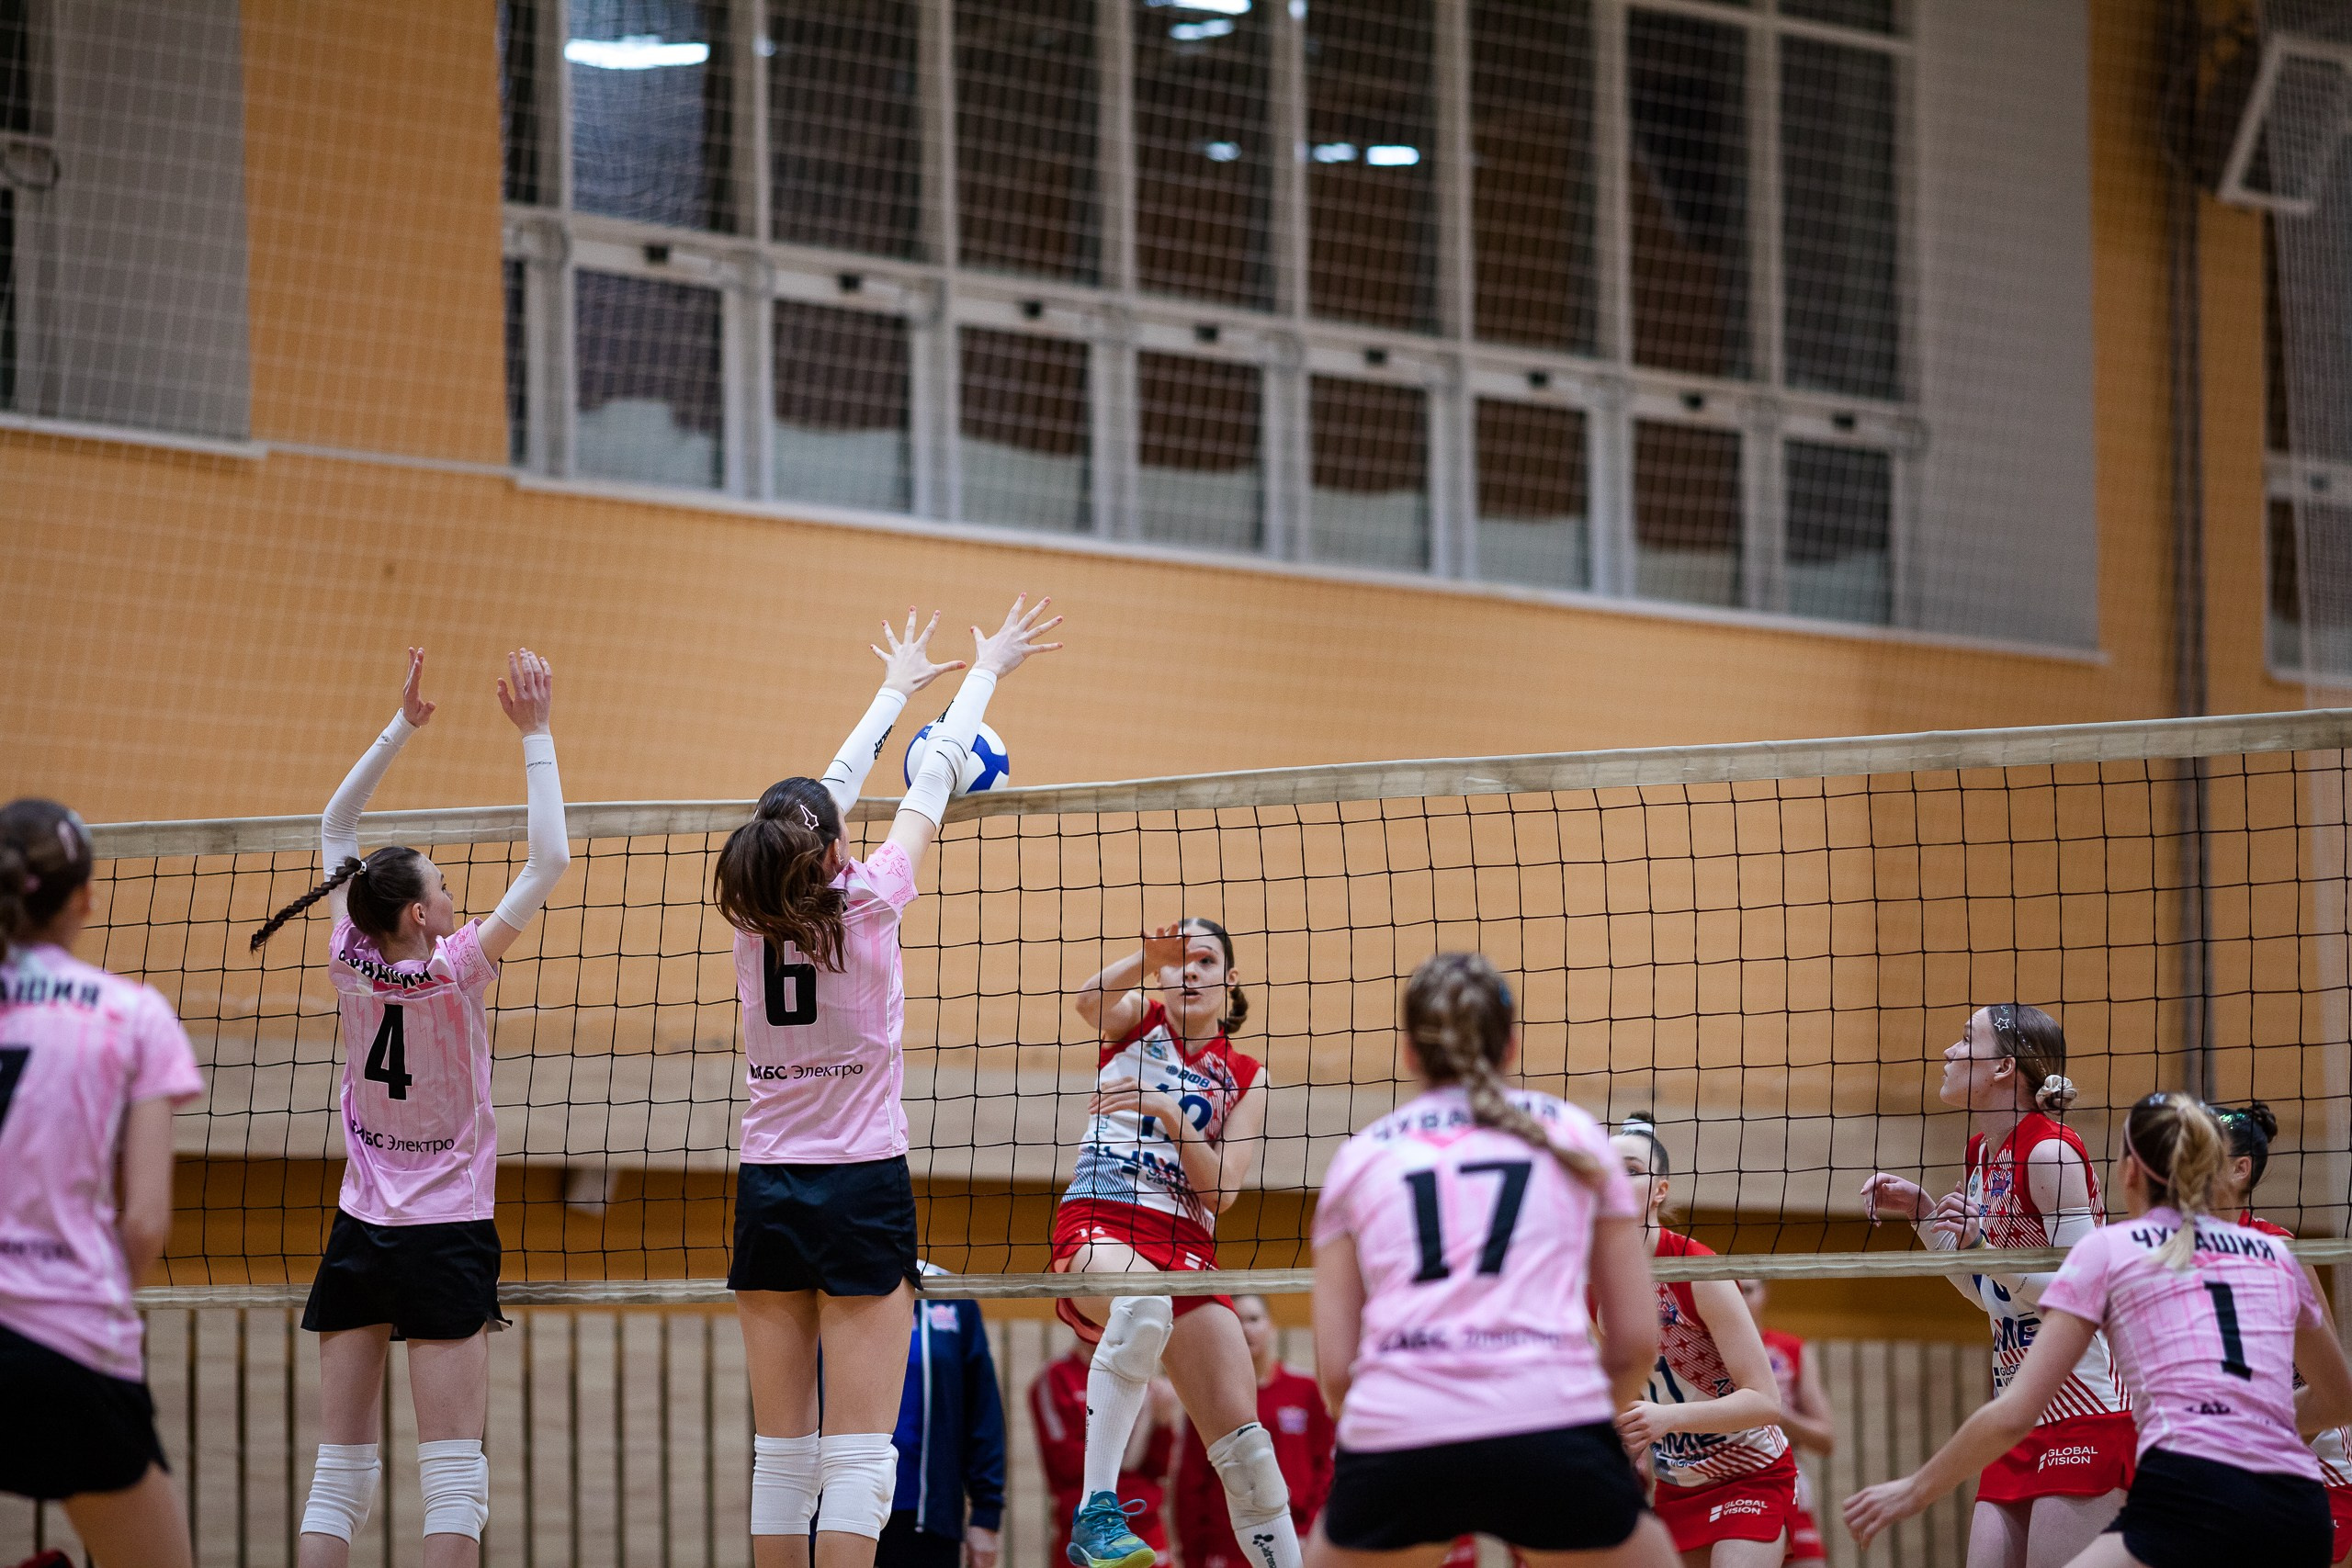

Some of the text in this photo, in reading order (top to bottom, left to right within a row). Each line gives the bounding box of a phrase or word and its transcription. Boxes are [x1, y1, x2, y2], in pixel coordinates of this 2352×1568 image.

[763, 930, 818, 1027] 6
[365, 1003, 413, 1101] 4
[791, 1063, 864, 1079] Электро
[1177, 1069, 1211, 1089] ВФВ
[387, 1134, 455, 1155] Электро
[1404, 1160, 1532, 1284] 17
[2131, 1226, 2276, 1261] ЧУАШИЯ
[2203, 1280, 2253, 1382] 1
[2047, 1455, 2091, 1467] VISION
[2048, 1446, 2098, 1458] GLOBAL
[1723, 1506, 1761, 1516] VISION
[1724, 1498, 1769, 1509] GLOBAL
